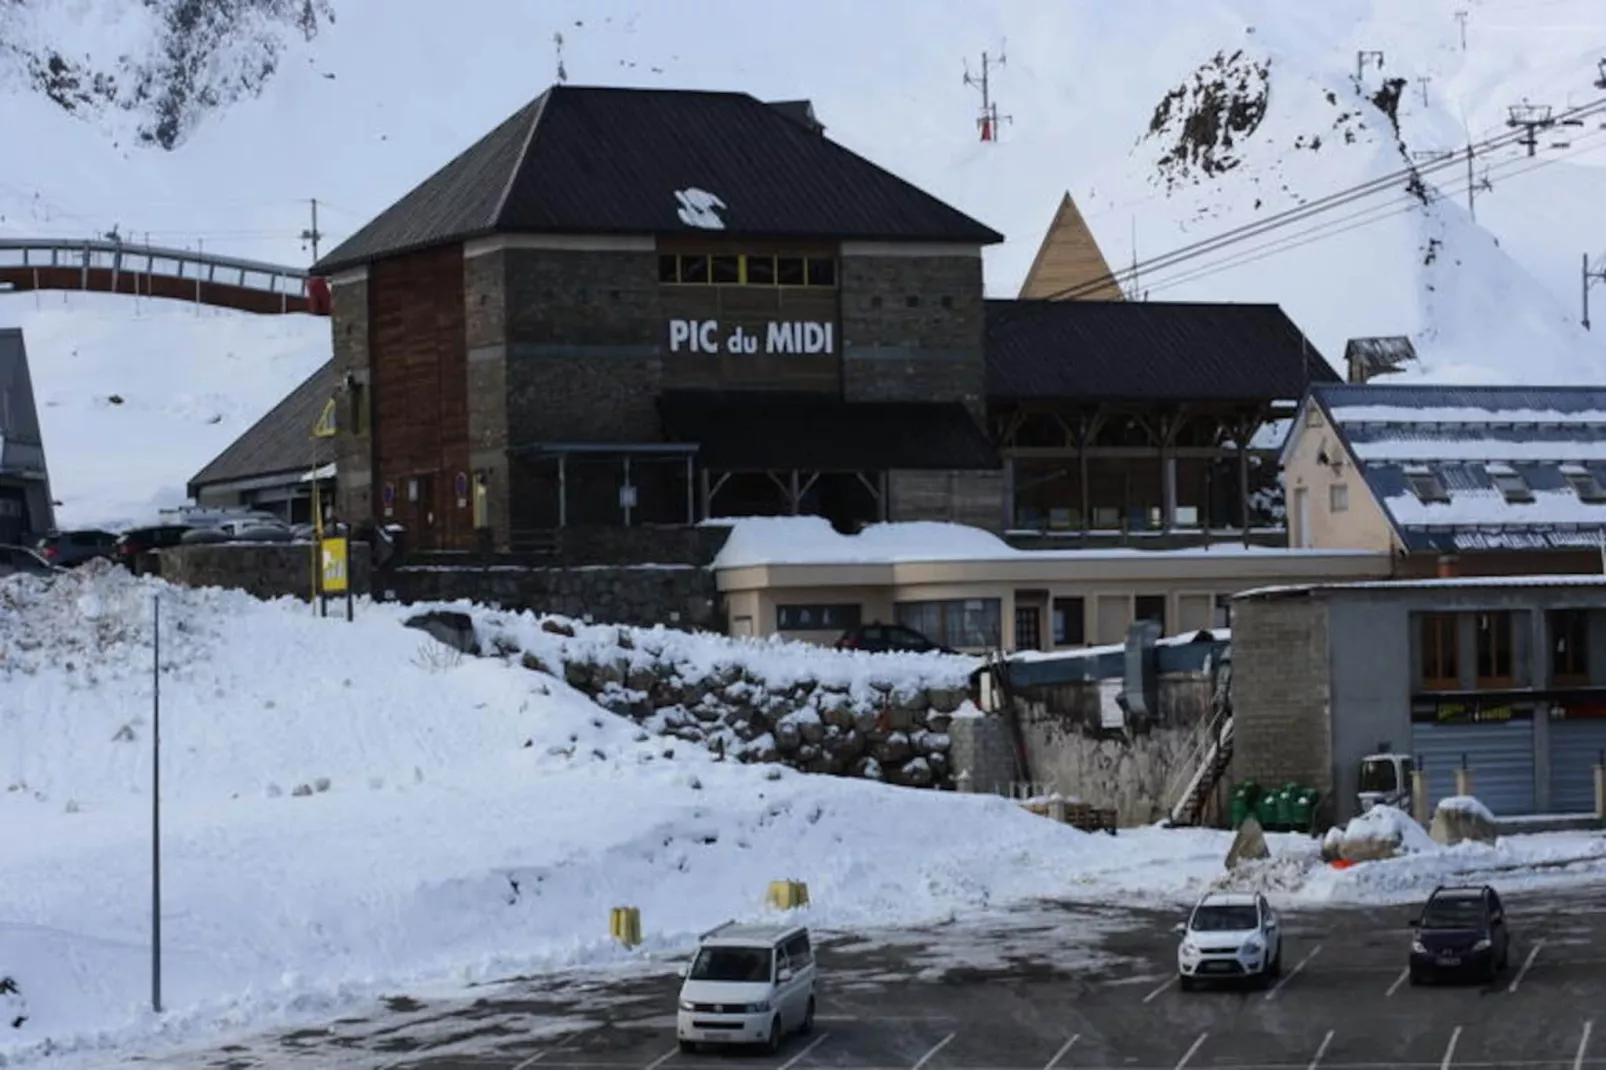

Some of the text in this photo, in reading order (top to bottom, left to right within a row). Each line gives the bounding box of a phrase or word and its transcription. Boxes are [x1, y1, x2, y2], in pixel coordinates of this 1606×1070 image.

[669, 319, 834, 354] PIC du MIDI
